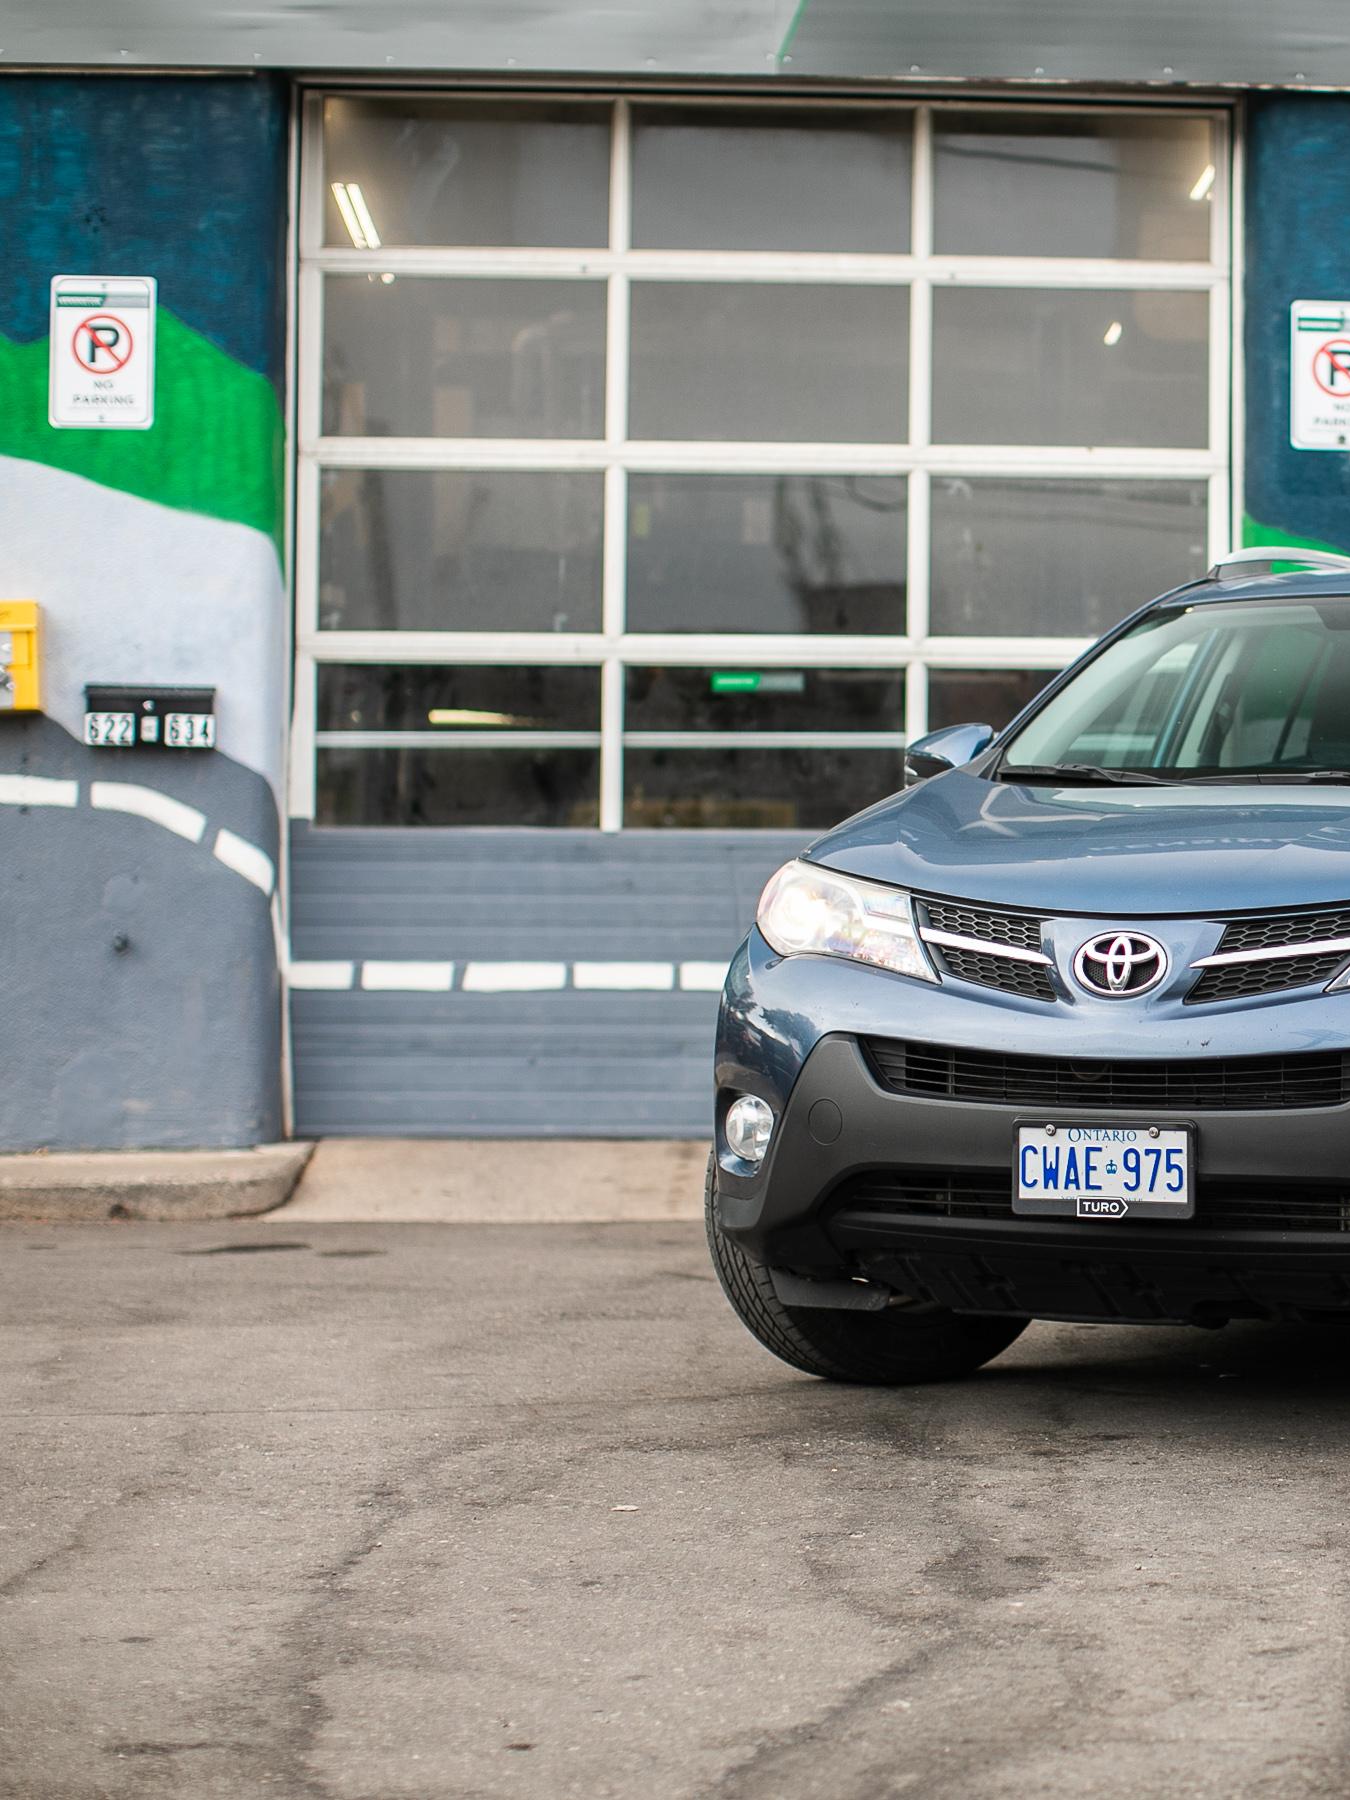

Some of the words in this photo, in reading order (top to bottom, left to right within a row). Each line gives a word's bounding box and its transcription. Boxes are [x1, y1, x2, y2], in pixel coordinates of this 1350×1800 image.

[88, 714, 131, 743] 622
[169, 714, 209, 745] 634
[1068, 1127, 1137, 1144] ONTARIO
[1021, 1145, 1103, 1190] CWAE
[1122, 1147, 1184, 1193] 975
[1082, 1201, 1120, 1213] TURO
